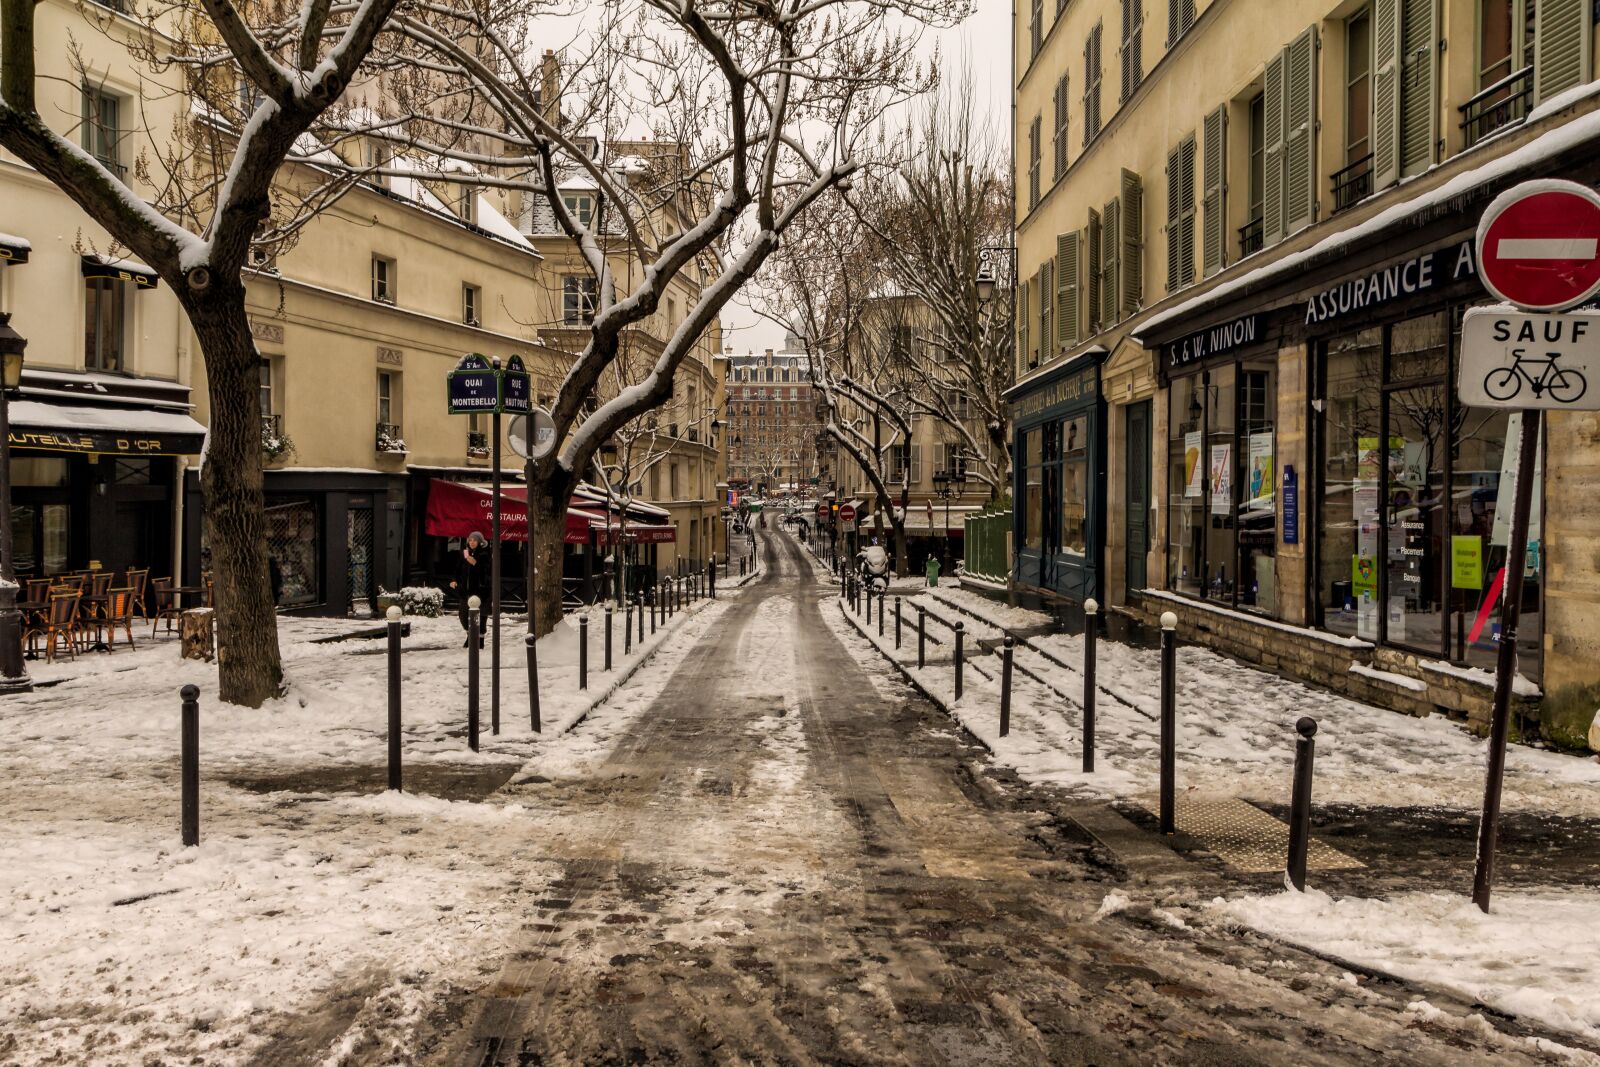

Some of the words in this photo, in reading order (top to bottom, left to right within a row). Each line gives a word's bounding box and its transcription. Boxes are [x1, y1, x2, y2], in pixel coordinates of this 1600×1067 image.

[1304, 253, 1433, 326] ASSURANCE
[1492, 319, 1589, 344] SAUF
[1170, 344, 1179, 366] S.
[1182, 340, 1190, 362] &
[1193, 334, 1206, 358] W.
[1210, 315, 1255, 353] NINON
[465, 379, 483, 387] QUAI
[511, 379, 522, 389] RUE
[452, 397, 497, 407] MONTEBELLO
[1400, 520, 1424, 530] Assurance
[1400, 546, 1424, 556] Placement
